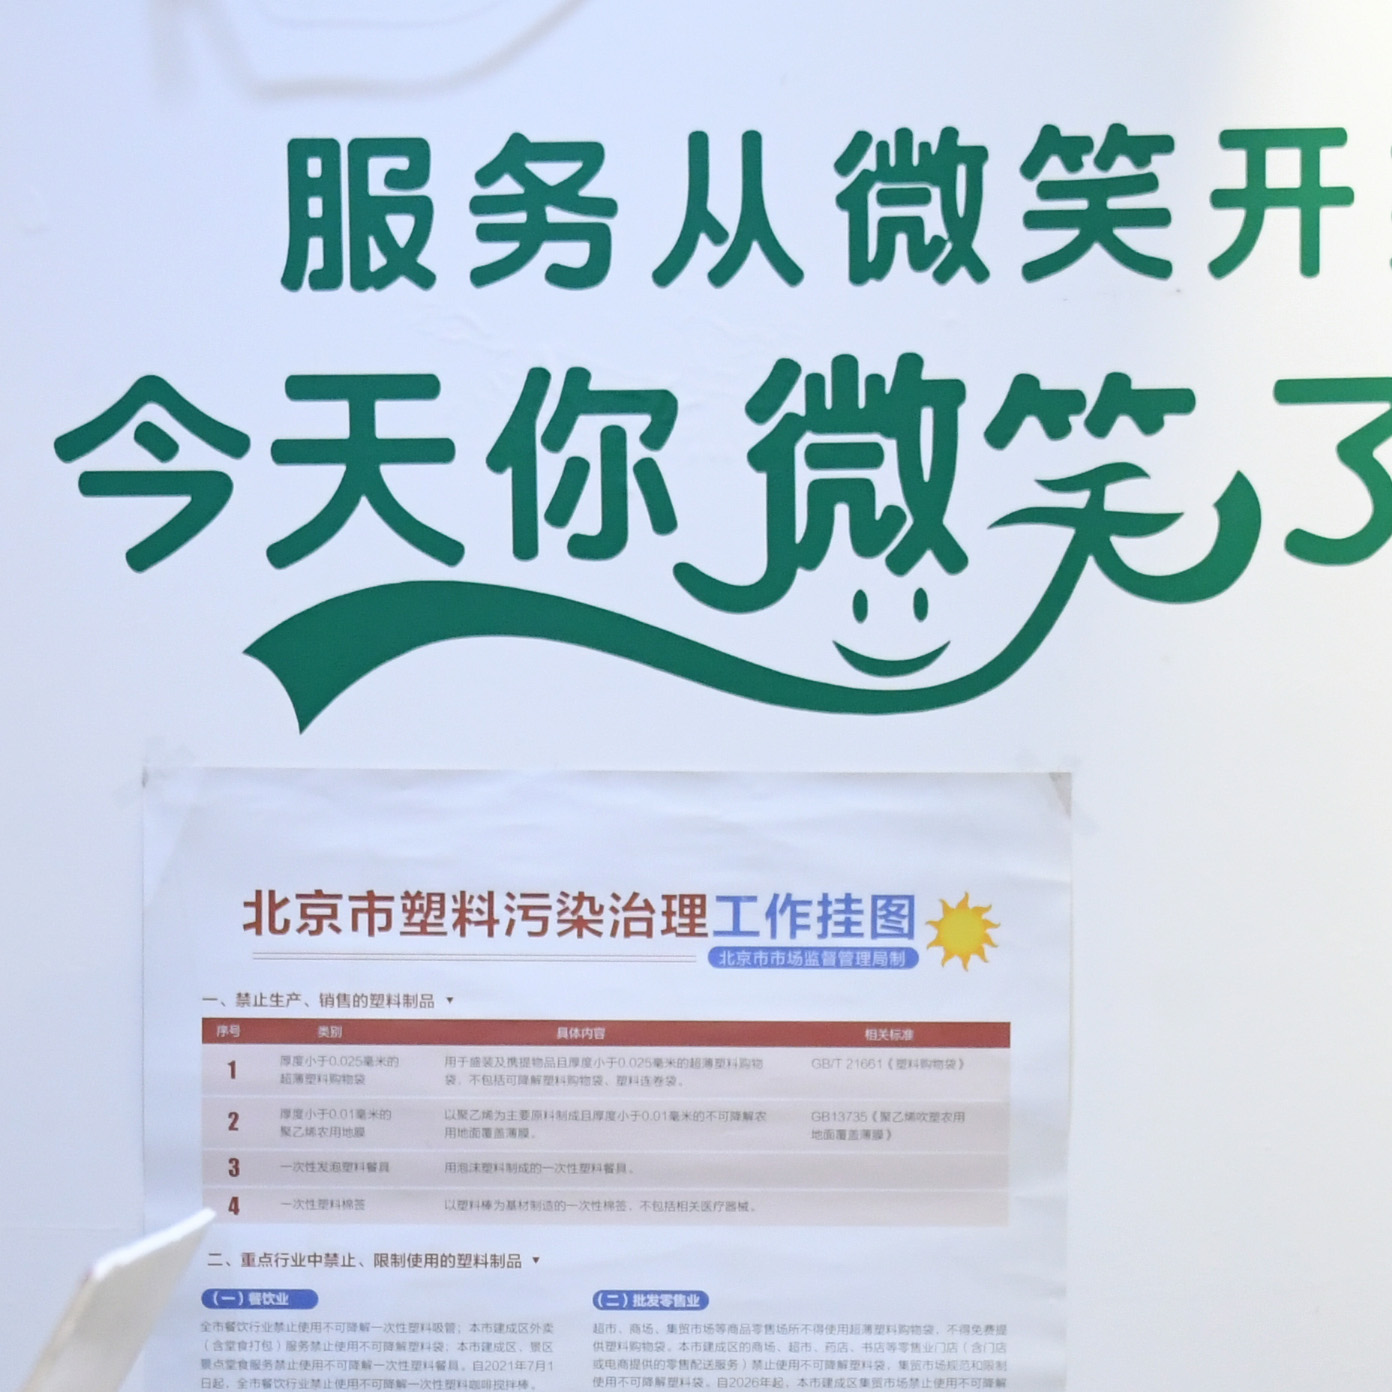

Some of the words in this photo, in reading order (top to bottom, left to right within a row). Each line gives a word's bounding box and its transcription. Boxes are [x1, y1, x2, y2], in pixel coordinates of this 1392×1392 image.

[242, 888, 915, 940] 北京市塑料污染治理工作挂图
[718, 949, 906, 968] 北京市市场监督管理局制
[202, 991, 435, 1009] 一、禁止生产、销售的塑料制品
[216, 1025, 241, 1038] 序号
[318, 1026, 342, 1039] 类别
[556, 1026, 605, 1040] 具体内容
[865, 1028, 914, 1042] 相关标准
[280, 1055, 400, 1069] 厚度小于0.025毫米的
[811, 1057, 842, 1071] GB/T
[227, 1060, 236, 1080] 1
[280, 1072, 366, 1087] 超薄塑料购物袋
[227, 1112, 239, 1132] 2
[280, 1107, 391, 1122] 厚度小于0.01毫米的
[280, 1125, 366, 1139] 聚乙烯农用地膜
[228, 1157, 240, 1178] 3
[280, 1160, 391, 1175] 一次性发泡塑料餐具
[228, 1197, 240, 1216] 4
[280, 1197, 366, 1212] 一次性塑料棉签
[208, 1252, 523, 1269] 二、重点行业中禁止、限制使用的塑料制品
